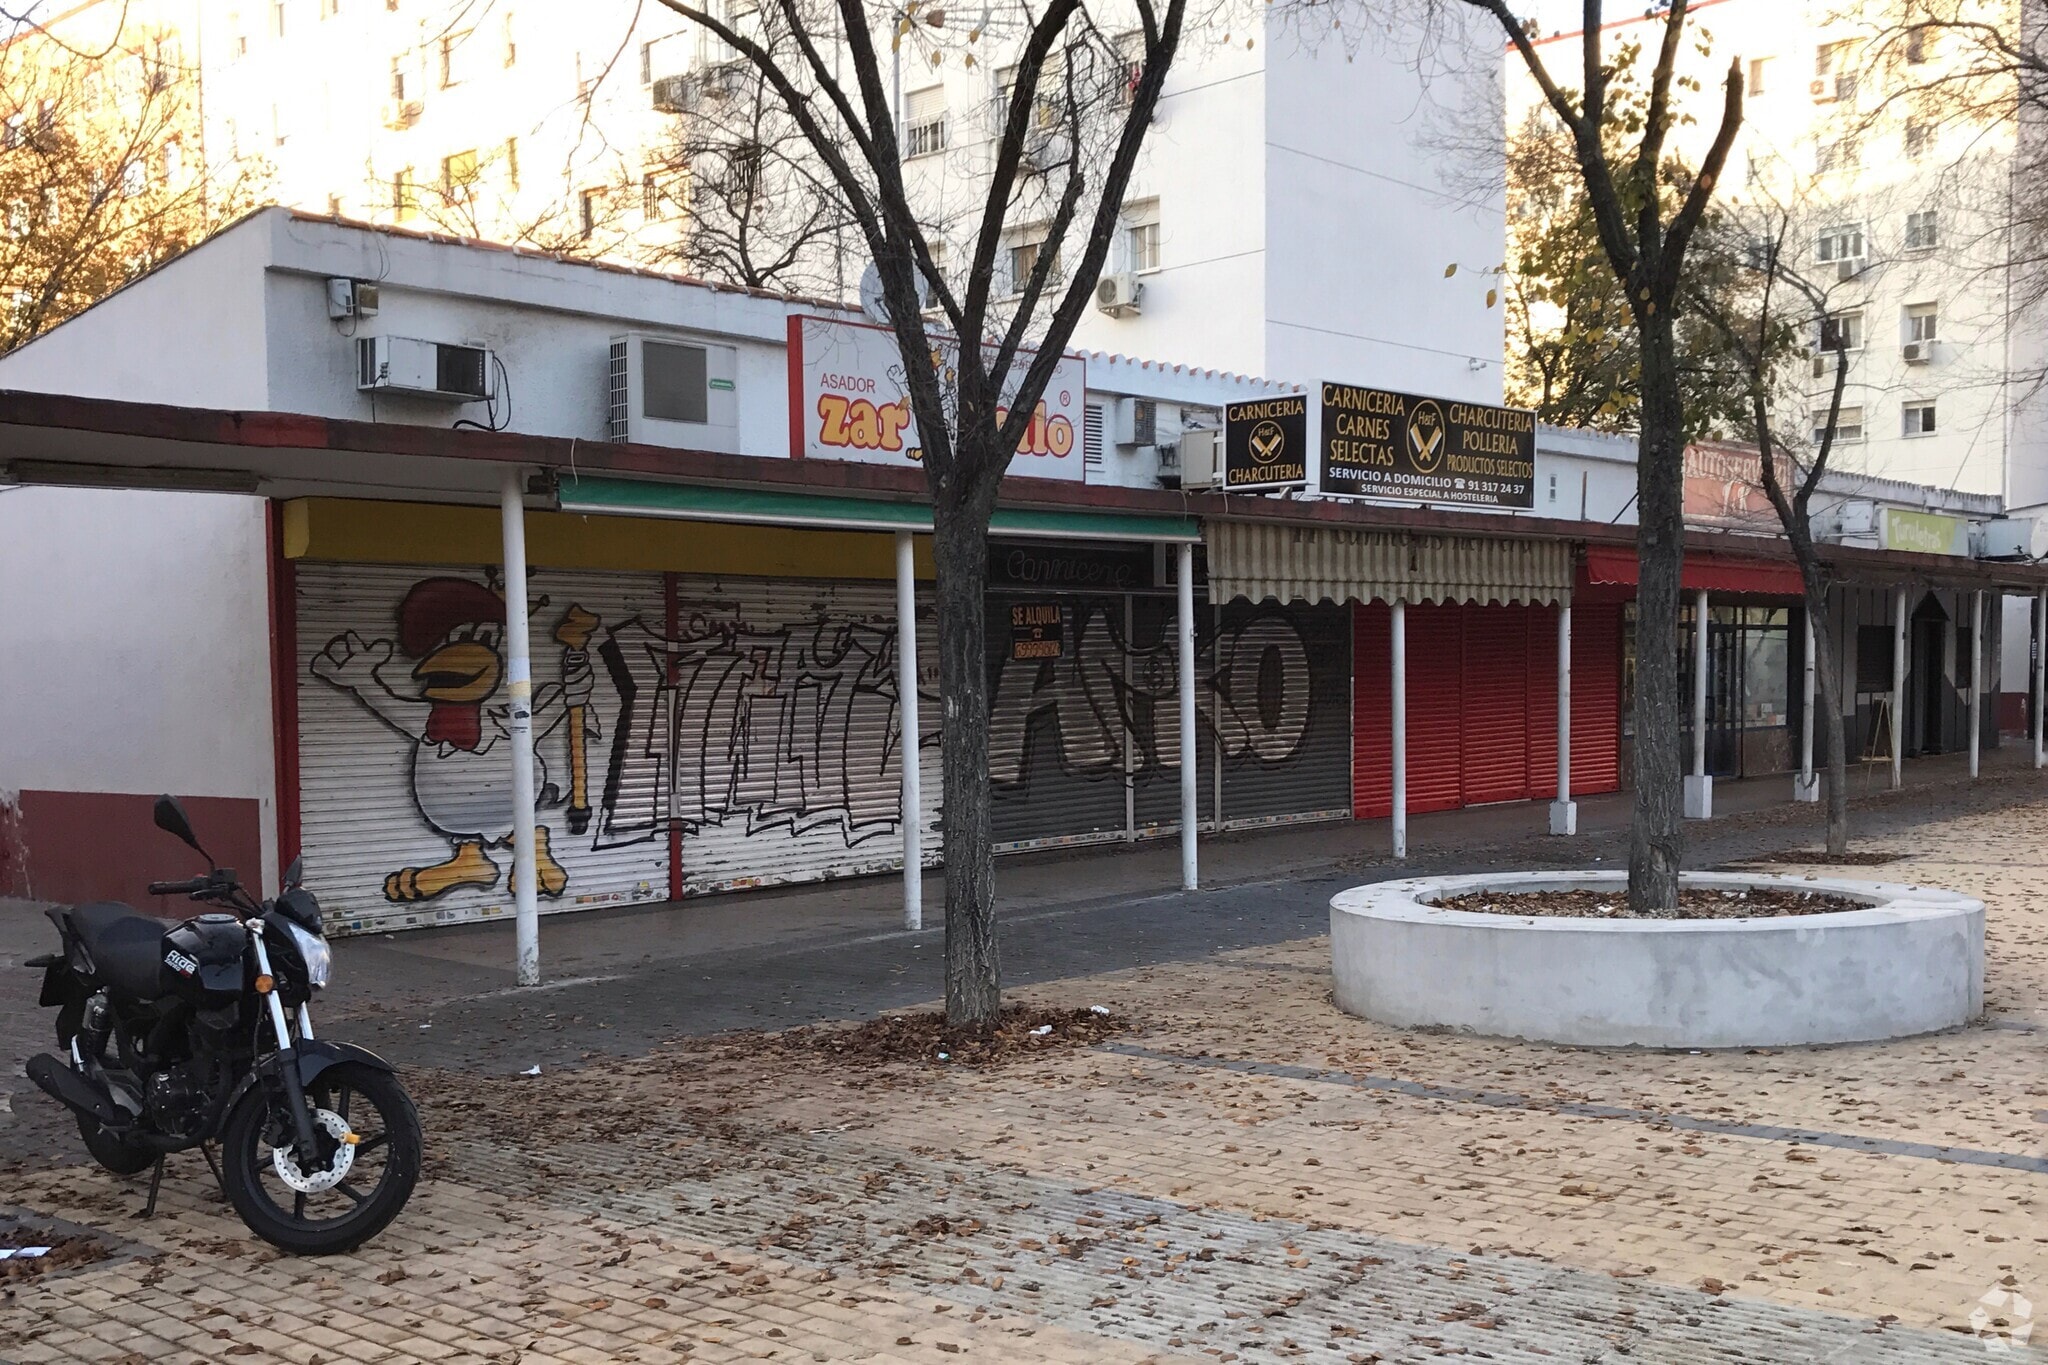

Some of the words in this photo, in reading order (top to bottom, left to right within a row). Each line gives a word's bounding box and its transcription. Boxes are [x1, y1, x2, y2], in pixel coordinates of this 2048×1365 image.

[820, 373, 876, 394] ASADOR
[1228, 400, 1305, 422] CARNICERIA
[1321, 384, 1405, 417] CARNICERIA
[1336, 413, 1390, 440] CARNES
[1449, 403, 1533, 433] CHARCUTERIA
[1330, 439, 1394, 467] SELECTAS
[1462, 430, 1519, 456] POLLERIA
[1228, 463, 1304, 484] CHARCUTERIA
[1446, 453, 1495, 476] PRODUCTOS
[1496, 459, 1533, 479] SELECTOS
[1328, 466, 1381, 482] SERVICIO
[1383, 472, 1392, 483] A
[1393, 473, 1452, 488] DOMICILIO
[1467, 480, 1480, 491] 91
[1481, 482, 1499, 493] 317
[1500, 483, 1512, 494] 24
[1513, 484, 1525, 495] 37
[1361, 484, 1402, 496] SERVICIO
[1403, 487, 1442, 499] ESPECIAL
[1443, 490, 1450, 500] A
[1450, 491, 1499, 503] HOSTELERIA
[1012, 606, 1024, 626] SE
[1025, 605, 1061, 625] ALQUILA
